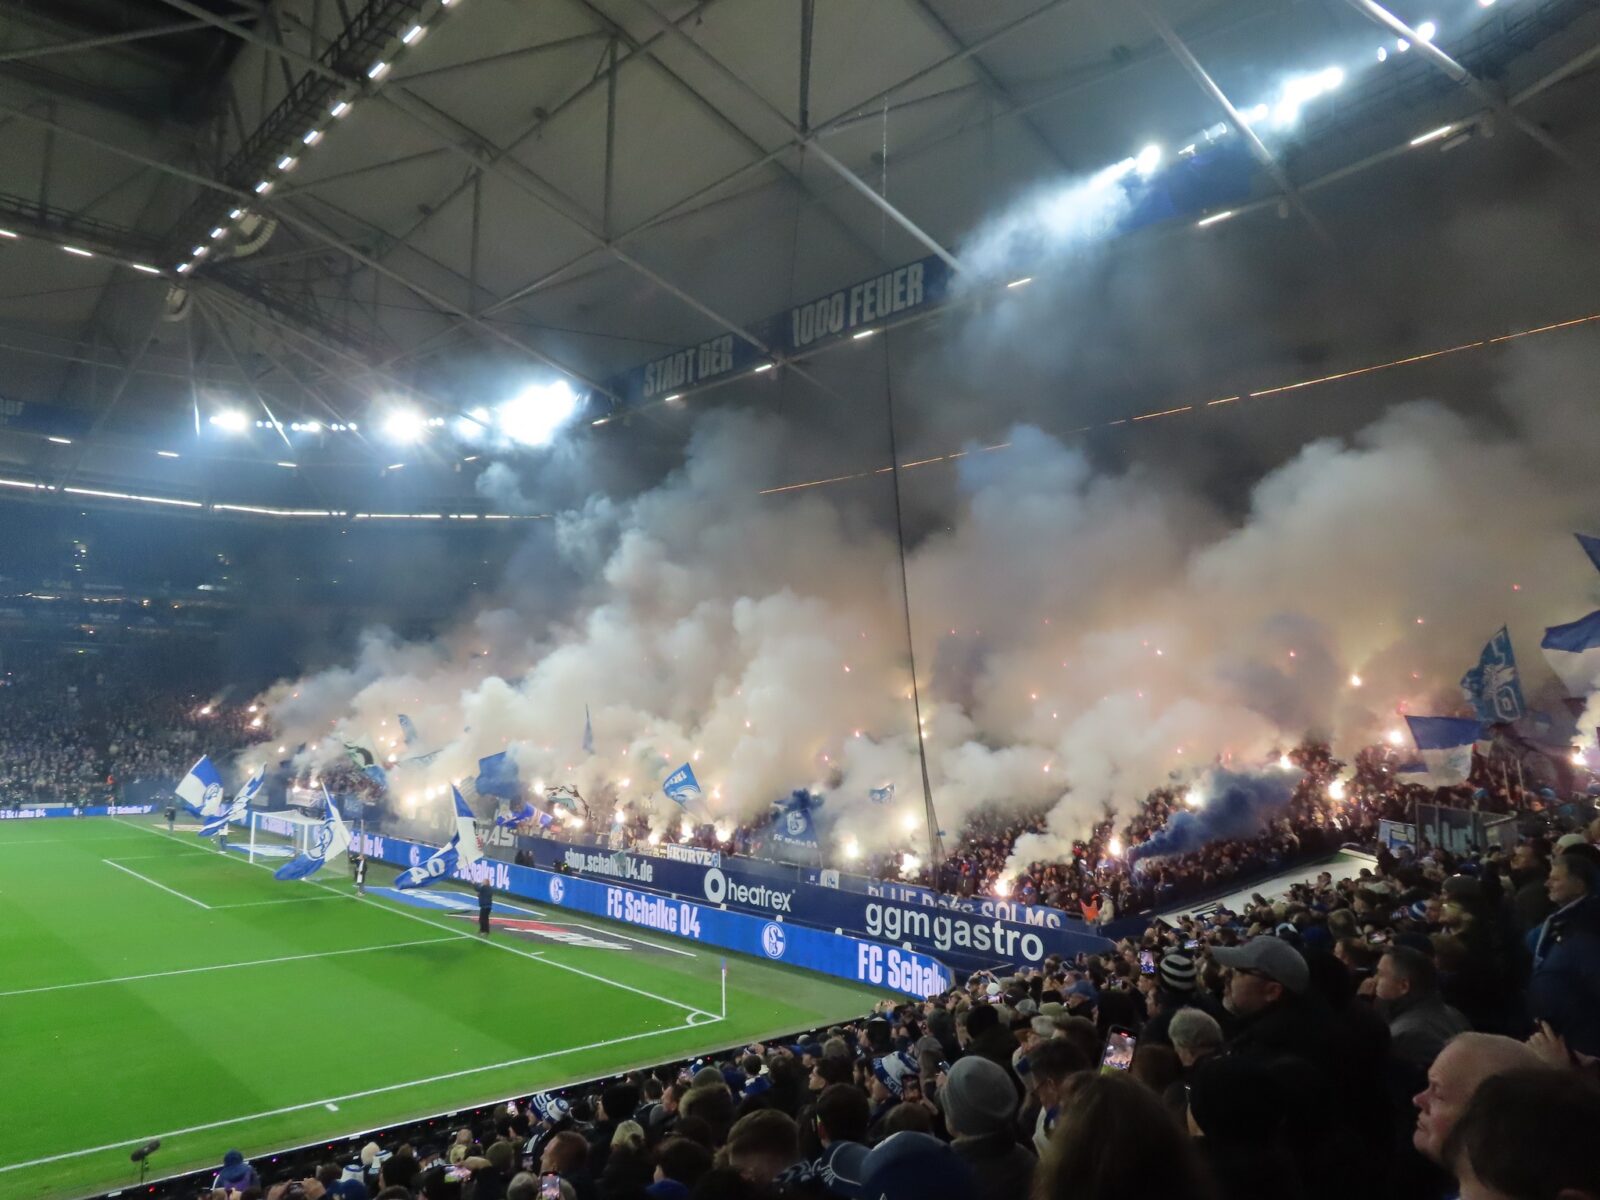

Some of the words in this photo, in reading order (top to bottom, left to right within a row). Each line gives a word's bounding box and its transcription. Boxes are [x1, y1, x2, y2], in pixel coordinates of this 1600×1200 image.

[792, 291, 846, 348] 1000
[849, 261, 924, 327] FEUER
[643, 347, 697, 398] STADT
[697, 333, 734, 380] DER
[496, 863, 510, 890] 04
[727, 877, 792, 912] heatrex
[607, 887, 623, 919] FC
[625, 892, 678, 933] Schalke
[680, 903, 701, 938] 04
[858, 942, 882, 985] FC
